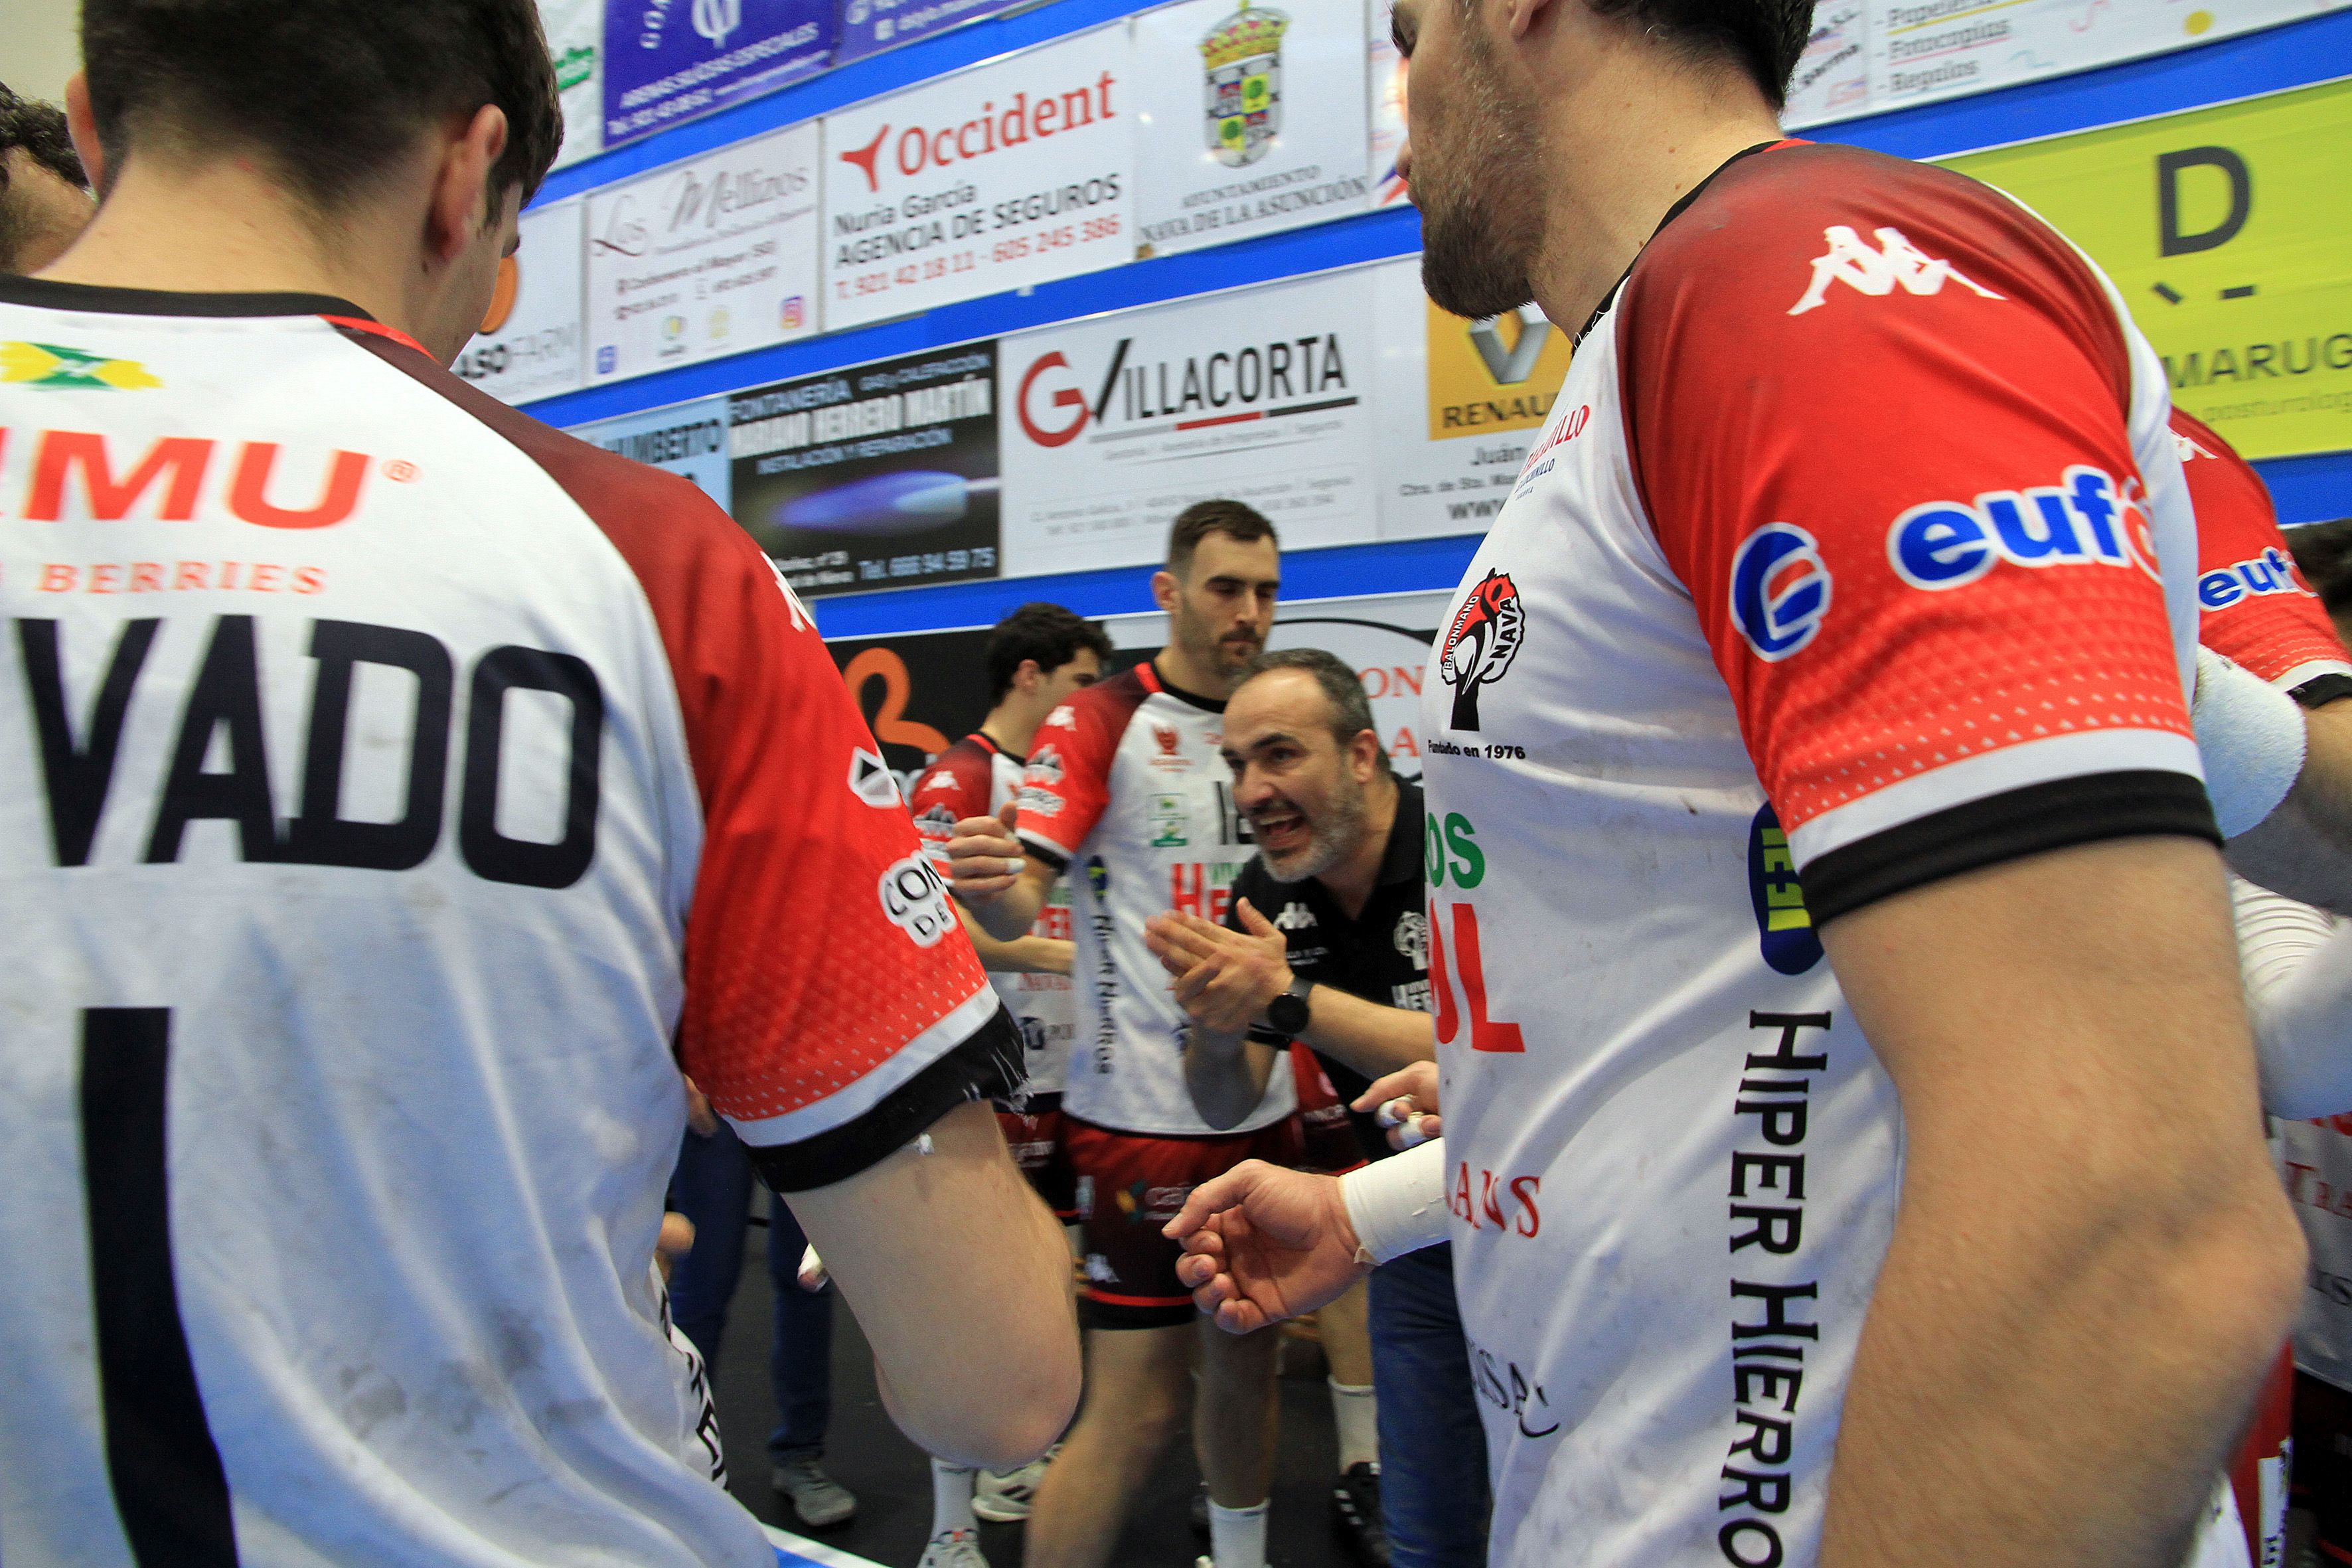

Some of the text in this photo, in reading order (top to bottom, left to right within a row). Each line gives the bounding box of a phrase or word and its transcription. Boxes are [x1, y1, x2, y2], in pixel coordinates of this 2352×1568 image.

[897, 70, 1119, 176] Occident
[835, 220, 945, 269] AGENCIA
[951, 209, 986, 240] DE
[992, 173, 1121, 229] SEGUROS
[2156, 145, 2252, 258] D
[1442, 392, 1560, 429] RENAU
[38, 561, 327, 595] BERRIES
[1442, 595, 1479, 671] BALONMANO
[1490, 596, 1518, 660] NAVA
[13, 614, 605, 890] VADO
[1428, 739, 1526, 759] Fundado en 1976
[1728, 1009, 1832, 1255] HIPER
[1718, 1279, 1819, 1568] HIERRO
